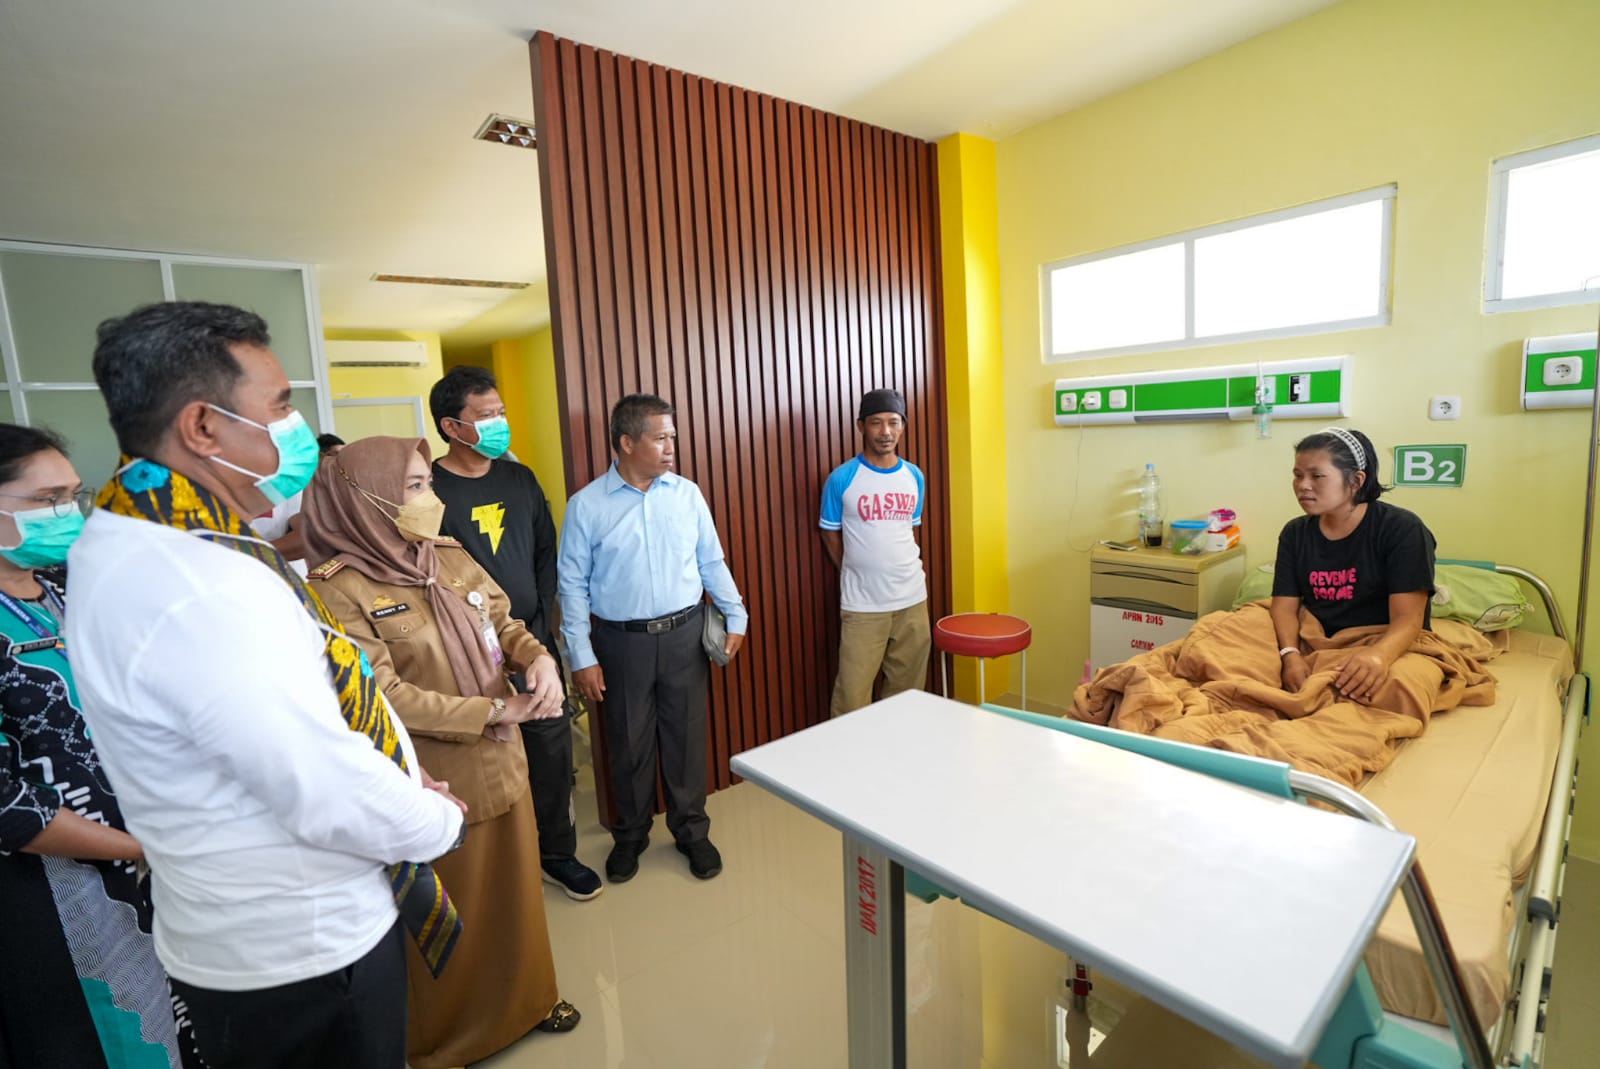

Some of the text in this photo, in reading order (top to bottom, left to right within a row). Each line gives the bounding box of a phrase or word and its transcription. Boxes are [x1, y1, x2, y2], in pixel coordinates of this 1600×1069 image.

[1404, 451, 1456, 482] B2
[858, 493, 916, 522] GASWA
[1145, 614, 1164, 626] 2015
[858, 856, 876, 900] 2017
